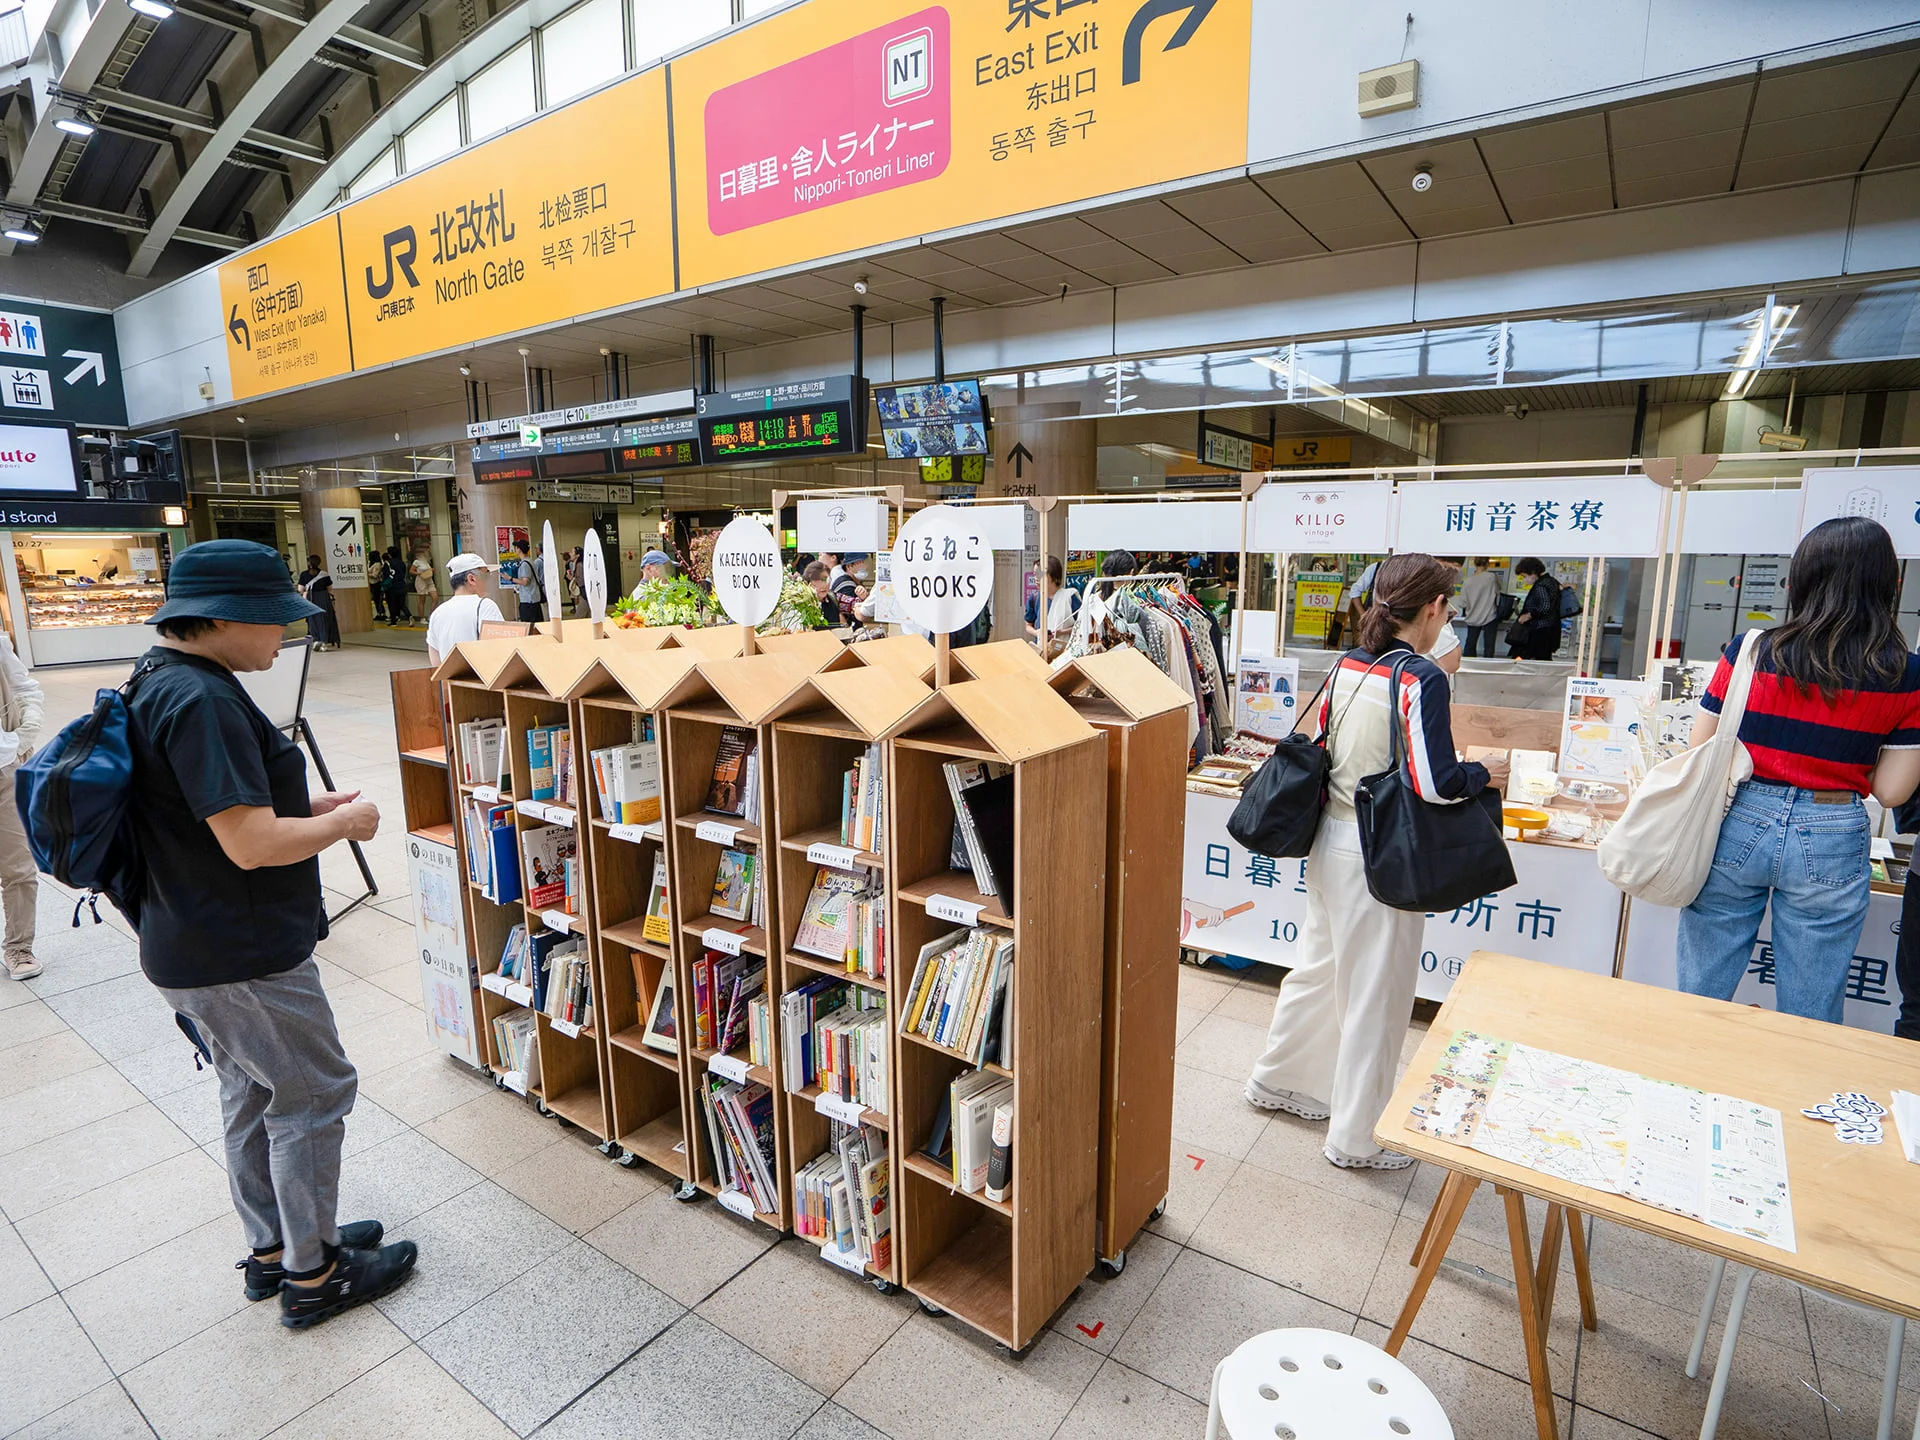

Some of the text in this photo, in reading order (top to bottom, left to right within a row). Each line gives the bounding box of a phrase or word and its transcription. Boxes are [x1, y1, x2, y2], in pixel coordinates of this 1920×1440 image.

[1005, 0, 1099, 33] 東
[892, 49, 924, 86] NT
[976, 22, 1099, 87] East Exit
[1025, 67, 1097, 111] 东出口
[989, 109, 1097, 162] 동쪽 출구
[719, 117, 935, 202] 日暮里・舎人ライナー
[794, 151, 935, 203] Nippori-Toneri Liner
[539, 183, 608, 230] 北检票口
[430, 188, 516, 265] 北改札
[541, 219, 637, 271] 북쪽 개찰구
[365, 224, 421, 300] JR
[247, 263, 269, 293] 西口
[435, 257, 525, 304] North Gate
[251, 281, 303, 323] (谷中方面)
[376, 295, 416, 322] JR東日本
[254, 307, 327, 342] West Exit (for Yanaka)
[575, 408, 585, 421] 10
[699, 398, 706, 413] 3
[613, 430, 620, 444] 4
[758, 417, 784, 430] 14:10
[759, 429, 785, 441] 14:18
[472, 447, 480, 459] 12
[1293, 441, 1320, 457] JR
[10, 510, 57, 523] stand
[1295, 513, 1346, 526] KILIG
[1446, 499, 1604, 532] 雨音茶寮
[1304, 530, 1335, 538] vintage
[719, 552, 773, 568] KAZENONE
[903, 535, 980, 563] ひるねこ
[336, 564, 364, 575] 化粧室
[732, 574, 761, 590] BOOK
[910, 575, 977, 599] BOOKS
[1308, 593, 1330, 606] 150
